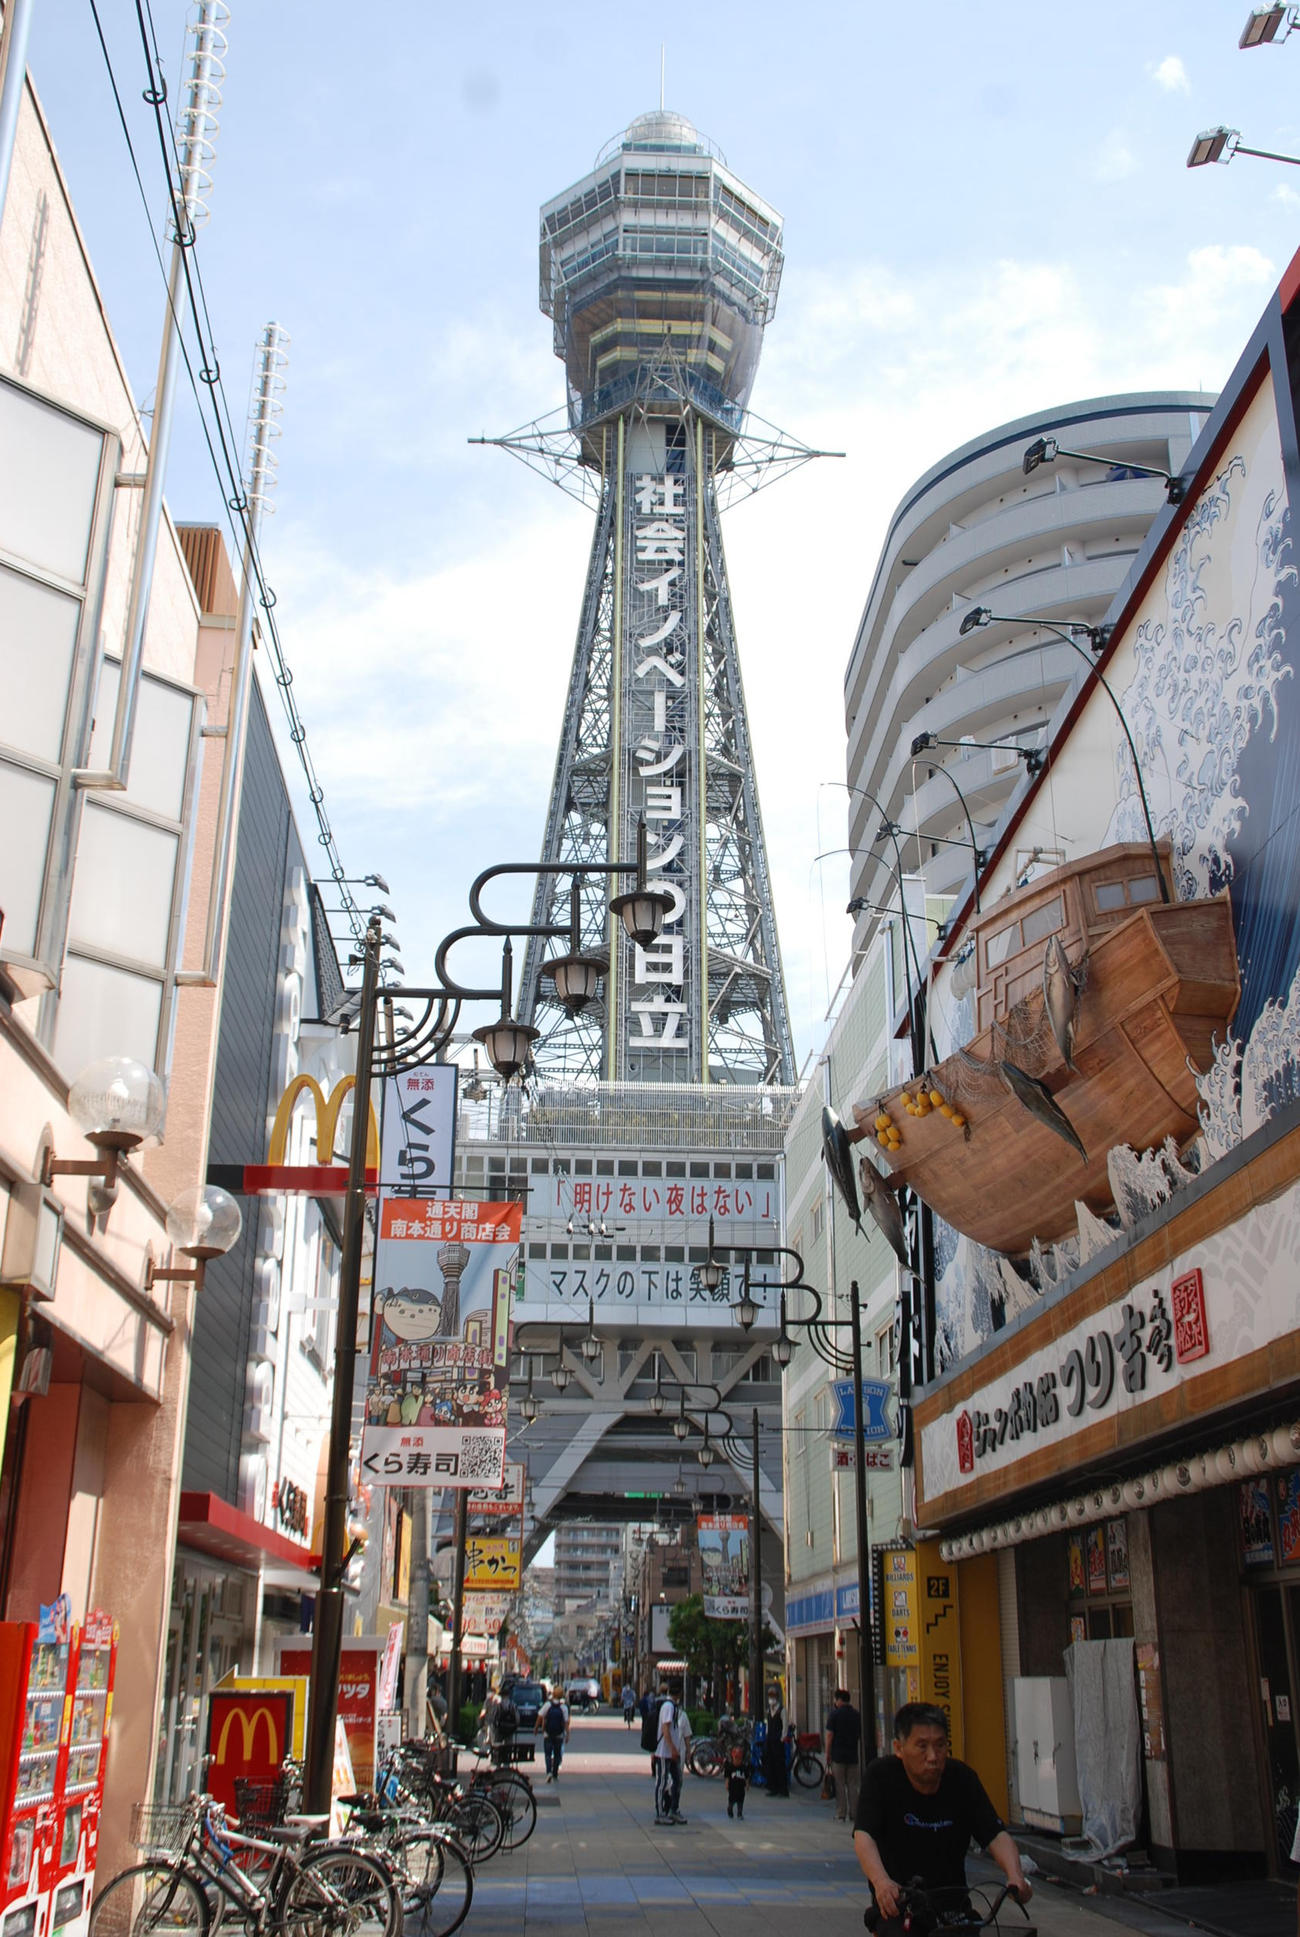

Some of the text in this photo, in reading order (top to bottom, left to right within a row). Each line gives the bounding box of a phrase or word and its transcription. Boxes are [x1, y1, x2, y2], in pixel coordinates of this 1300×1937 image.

[406, 1078, 434, 1091] 無添
[556, 1180, 770, 1218] 「明けない夜はない」
[426, 1202, 479, 1220] 通天閣
[390, 1219, 511, 1241] 南本通り商店会
[839, 1385, 884, 1398] LASON
[401, 1436, 424, 1447] 無添
[363, 1452, 460, 1476] くら寿司
[837, 1452, 890, 1467] 酒・ばこ
[465, 1541, 517, 1576] 串かつ
[929, 1579, 947, 1597] 2F
[933, 1653, 950, 1699] ENJOY
